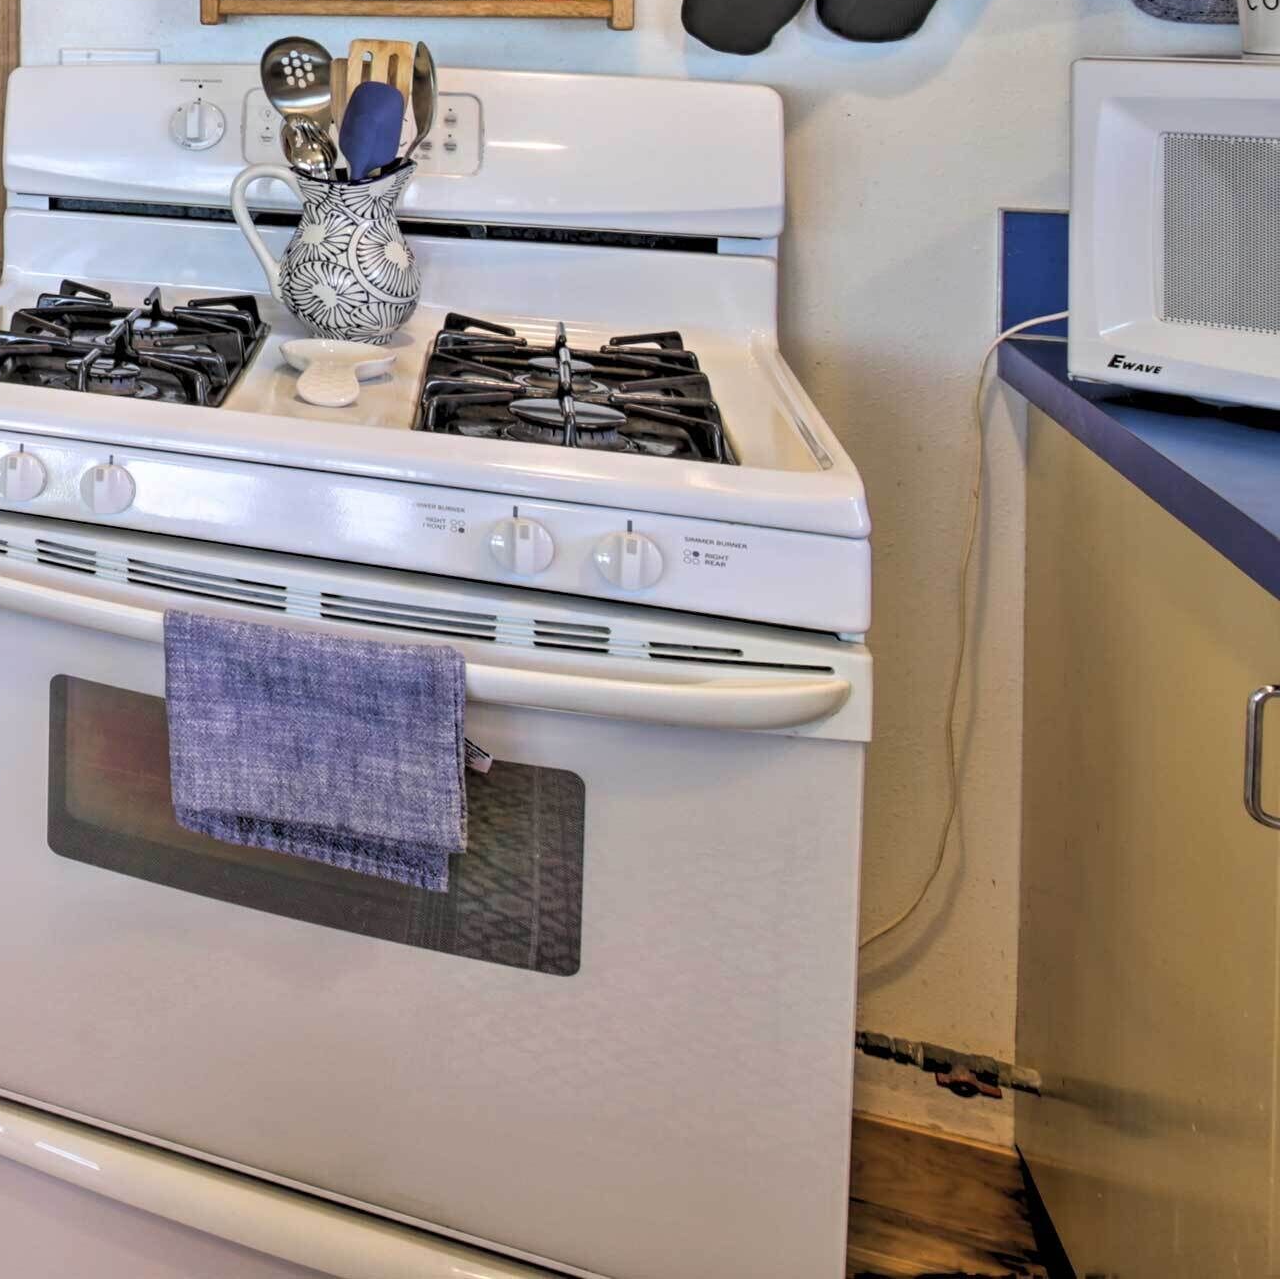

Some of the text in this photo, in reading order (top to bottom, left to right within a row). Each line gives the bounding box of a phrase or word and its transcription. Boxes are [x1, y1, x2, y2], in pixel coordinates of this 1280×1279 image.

[684, 536, 748, 549] SIMMER BURNER
[704, 552, 729, 561] RIGHT
[704, 560, 727, 568] REAR
